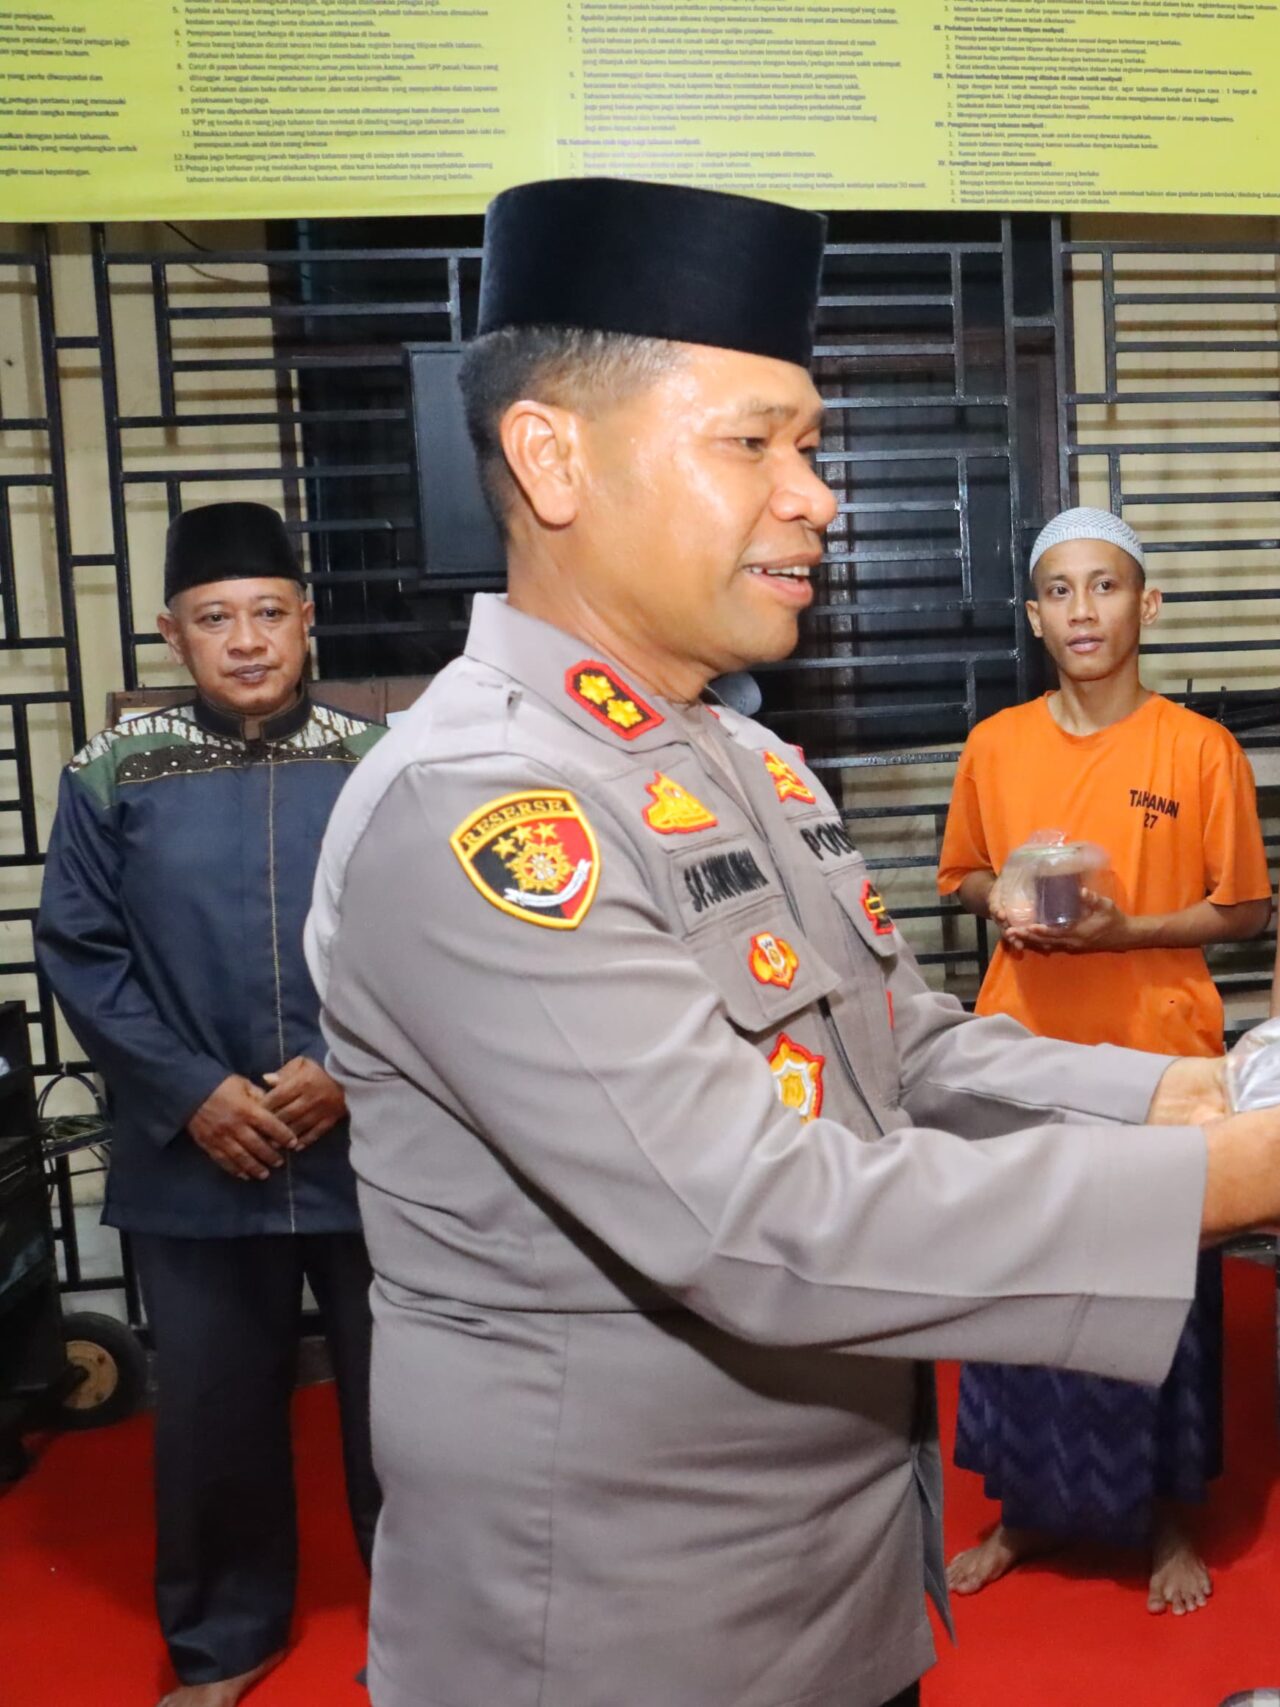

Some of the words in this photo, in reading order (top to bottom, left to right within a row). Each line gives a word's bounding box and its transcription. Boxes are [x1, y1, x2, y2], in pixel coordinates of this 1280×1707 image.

[1130, 789, 1180, 819] TAHANAN
[461, 799, 564, 848] RESERSE
[1144, 812, 1158, 829] 27
